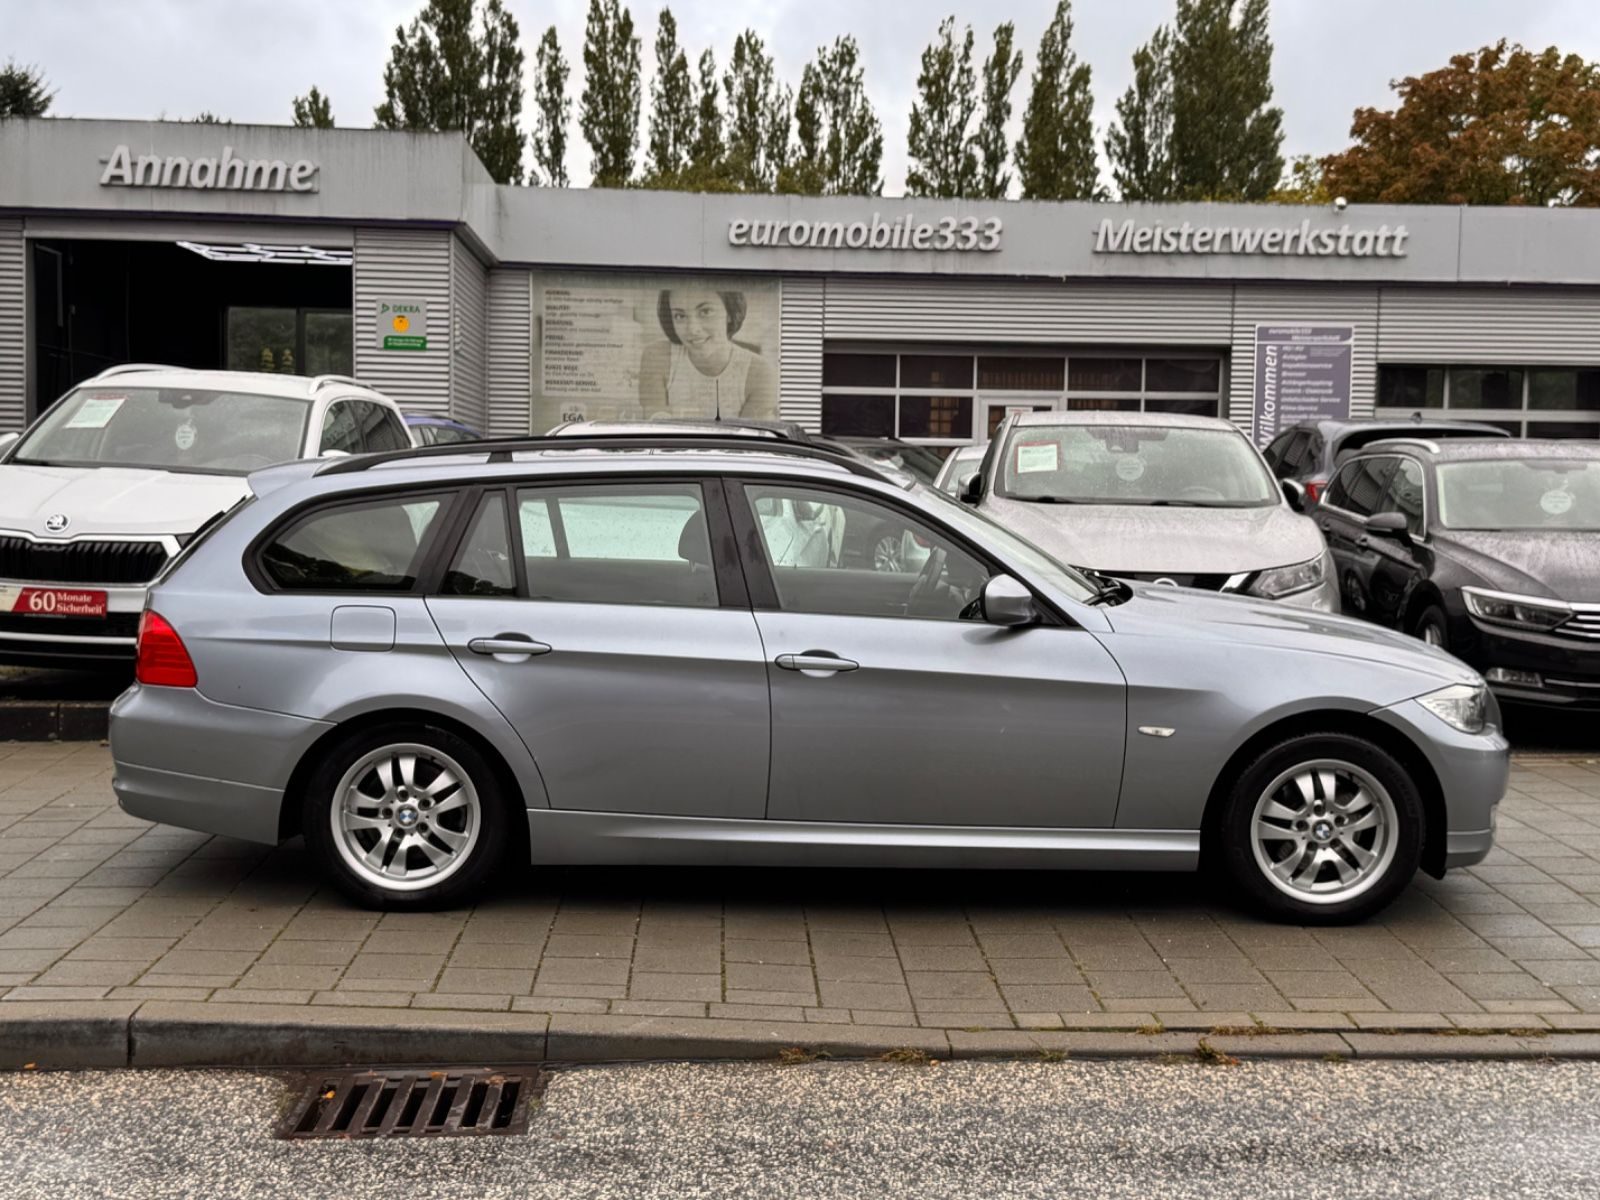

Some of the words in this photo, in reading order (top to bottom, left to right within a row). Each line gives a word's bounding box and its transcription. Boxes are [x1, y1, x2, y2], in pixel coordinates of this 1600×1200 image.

[100, 144, 315, 192] Annahme
[728, 212, 1003, 251] euromobile333
[1095, 218, 1409, 256] Meisterwerkstatt
[29, 591, 56, 612] 60
[57, 592, 92, 602] Monate
